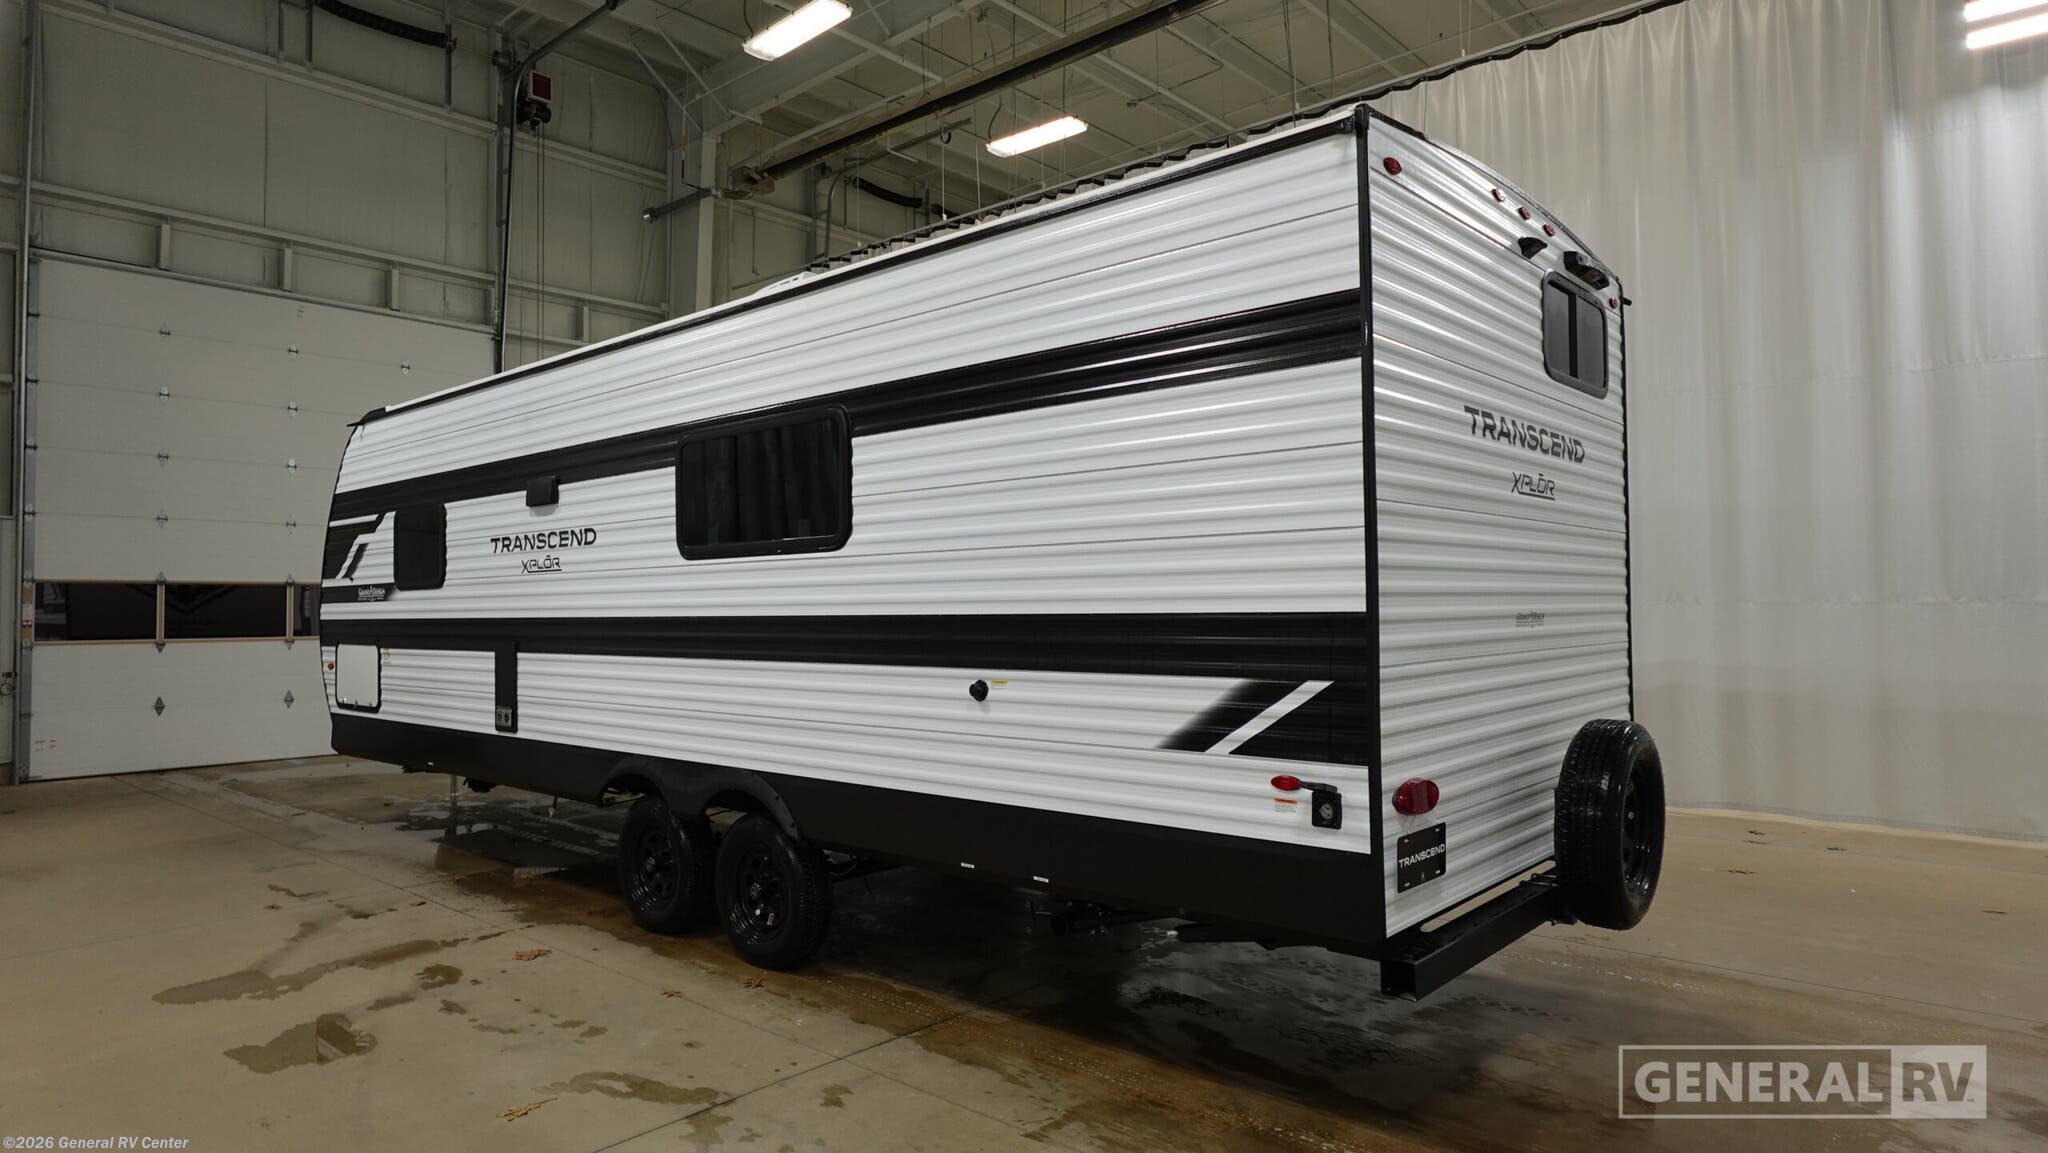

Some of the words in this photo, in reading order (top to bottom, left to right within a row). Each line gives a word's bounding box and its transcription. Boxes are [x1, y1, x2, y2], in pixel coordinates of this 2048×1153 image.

[1463, 404, 1585, 463] TRANSCEND
[490, 527, 597, 554] TRANSCEND
[1398, 843, 1446, 869] TRANSCEND
